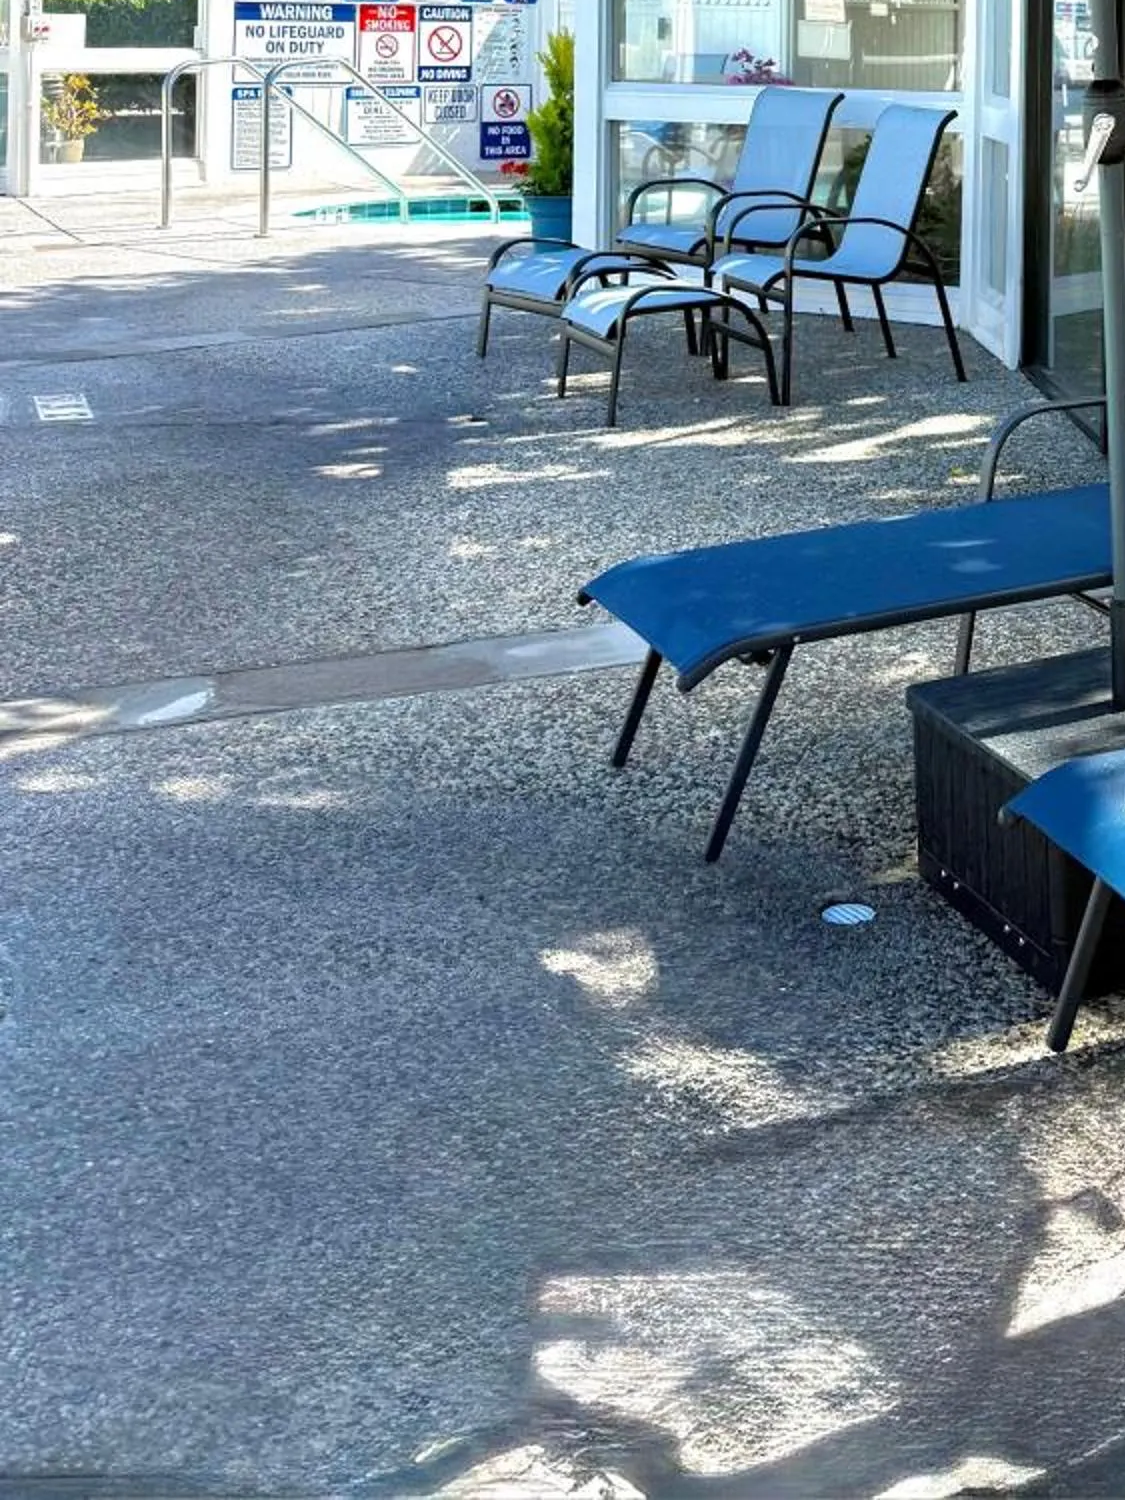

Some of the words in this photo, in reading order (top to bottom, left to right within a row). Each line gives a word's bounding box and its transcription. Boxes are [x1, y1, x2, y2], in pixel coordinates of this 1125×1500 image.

[259, 3, 334, 20] WARNING
[376, 6, 397, 19] NO
[422, 7, 470, 20] CAUTION
[364, 19, 411, 31] SMOKING
[245, 25, 265, 37] NO
[269, 26, 345, 39] LIFEGUARD
[265, 41, 286, 54] ON
[289, 41, 325, 54] DUTY
[421, 68, 435, 81] NO
[437, 69, 467, 80] DIVING
[428, 89, 450, 103] KEEP
[434, 105, 467, 120] CLOSED
[487, 126, 501, 135] NO
[502, 125, 525, 135] FOOD
[501, 136, 511, 145] IN
[484, 146, 503, 156] THIS
[504, 145, 527, 155] AREA
